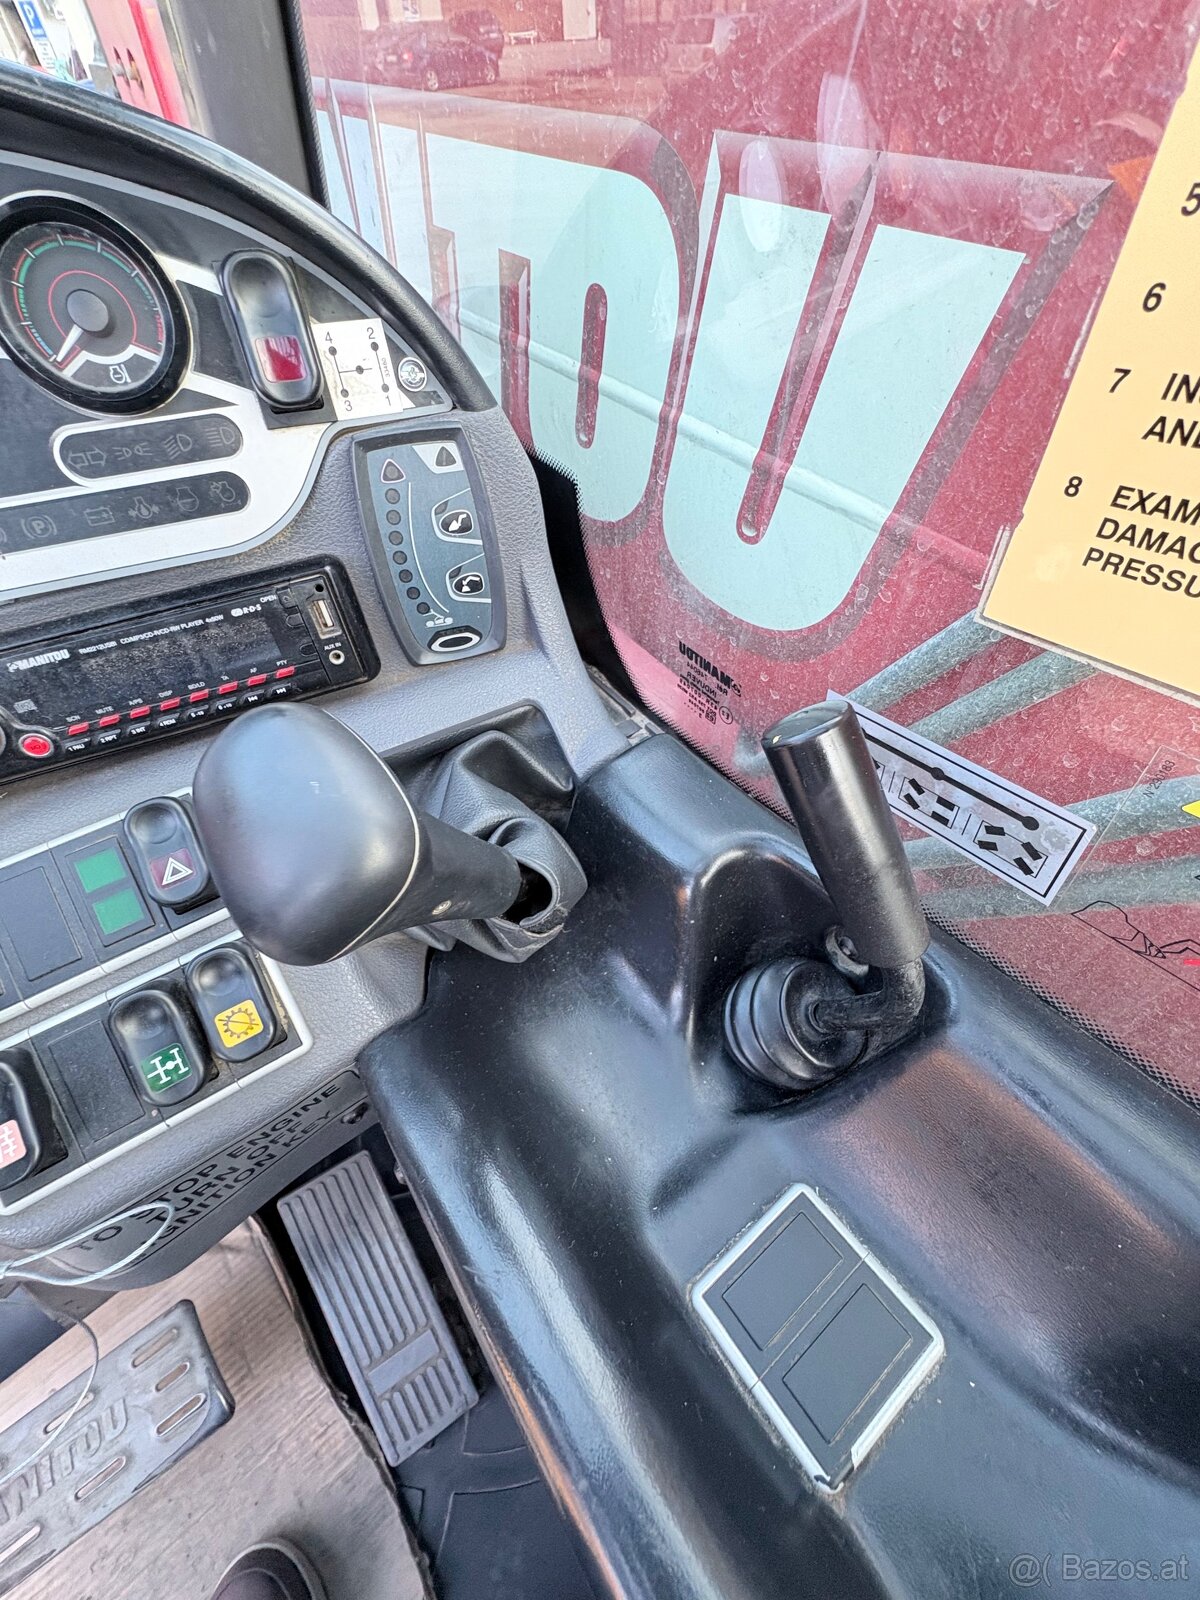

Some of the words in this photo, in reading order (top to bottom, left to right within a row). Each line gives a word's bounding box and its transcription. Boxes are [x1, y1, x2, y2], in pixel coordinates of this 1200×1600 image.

[23, 4, 35, 27] P
[1181, 182, 1200, 217] 5
[1142, 282, 1166, 313] 6
[325, 331, 333, 344] 4
[366, 326, 376, 340] 2
[1109, 367, 1131, 394] 7
[1161, 372, 1200, 405] IN
[343, 399, 353, 412] 3
[385, 395, 391, 406] 1
[1063, 475, 1083, 498] 8
[1110, 484, 1200, 528] EXAM
[259, 594, 277, 603] OPEN
[14, 648, 71, 672] MANITOU
[180, 619, 205, 630] PLAYER
[324, 643, 335, 651] AUX
[276, 659, 288, 667] PTY
[95, 705, 115, 715] MUTE
[105, 734, 118, 743] RPT
[281, 1110, 331, 1149] KEY
[67, 1225, 123, 1252] TO
[226, 1084, 341, 1159] ENGINE
[146, 1166, 241, 1224] TURN
[246, 1120, 303, 1161] OFF
